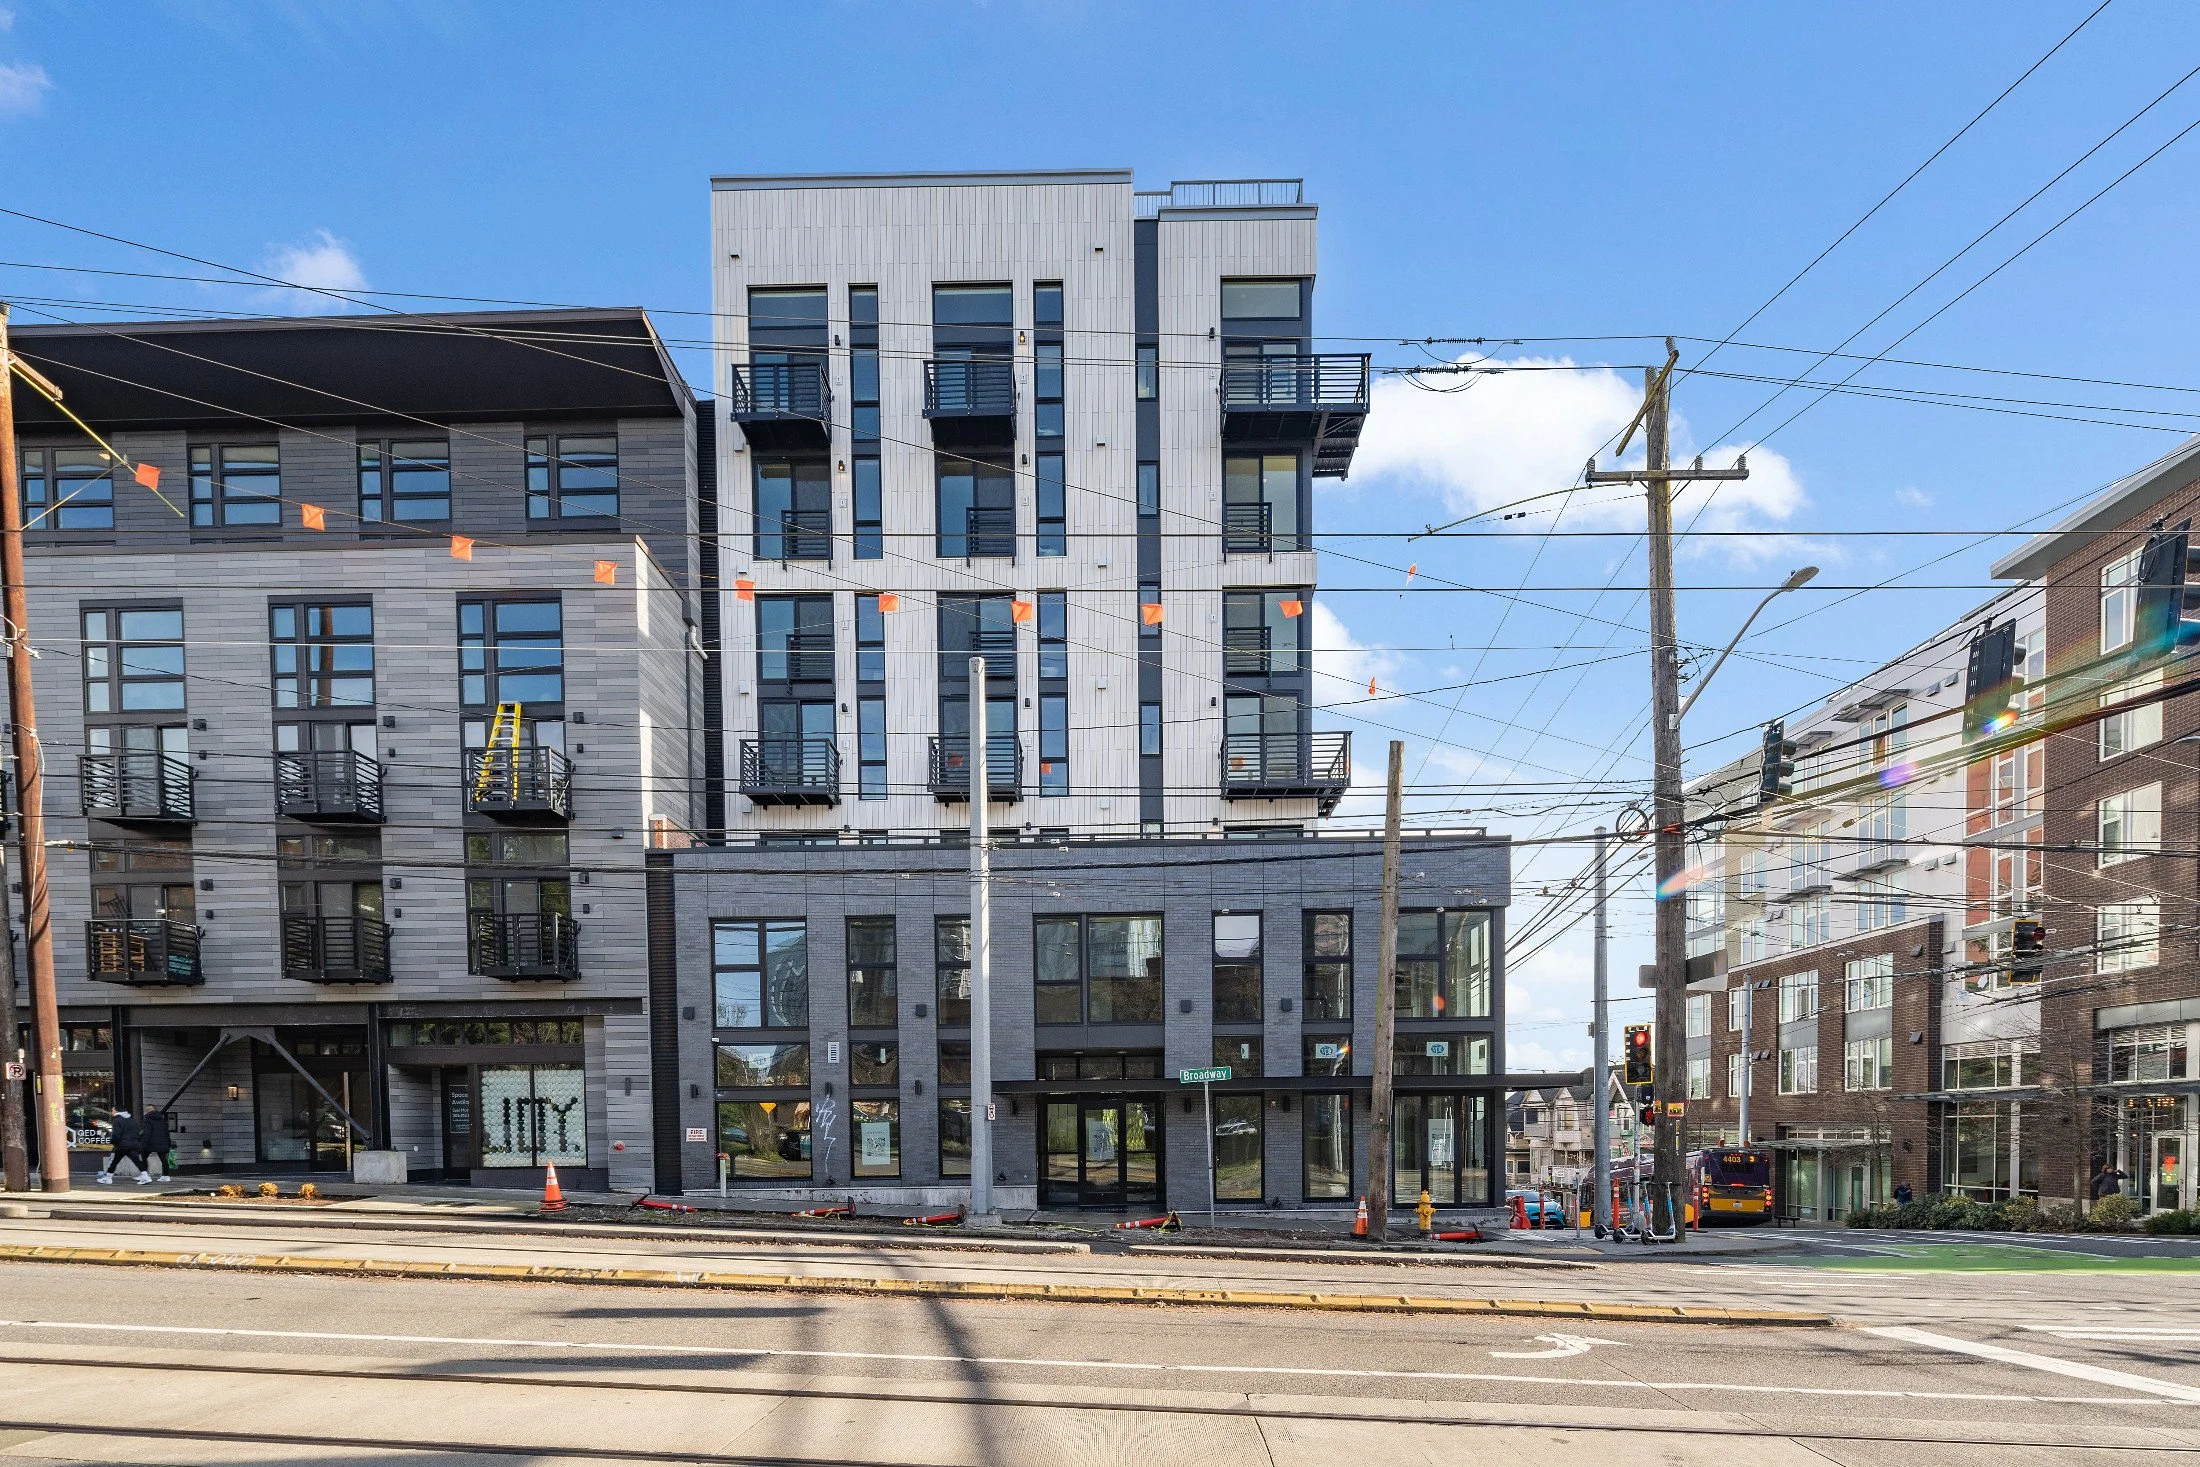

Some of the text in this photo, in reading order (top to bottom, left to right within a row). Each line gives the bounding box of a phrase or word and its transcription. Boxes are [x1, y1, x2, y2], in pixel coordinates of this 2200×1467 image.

[1183, 1069, 1227, 1080] Broadway
[1722, 1155, 1755, 1163] 4403 3
